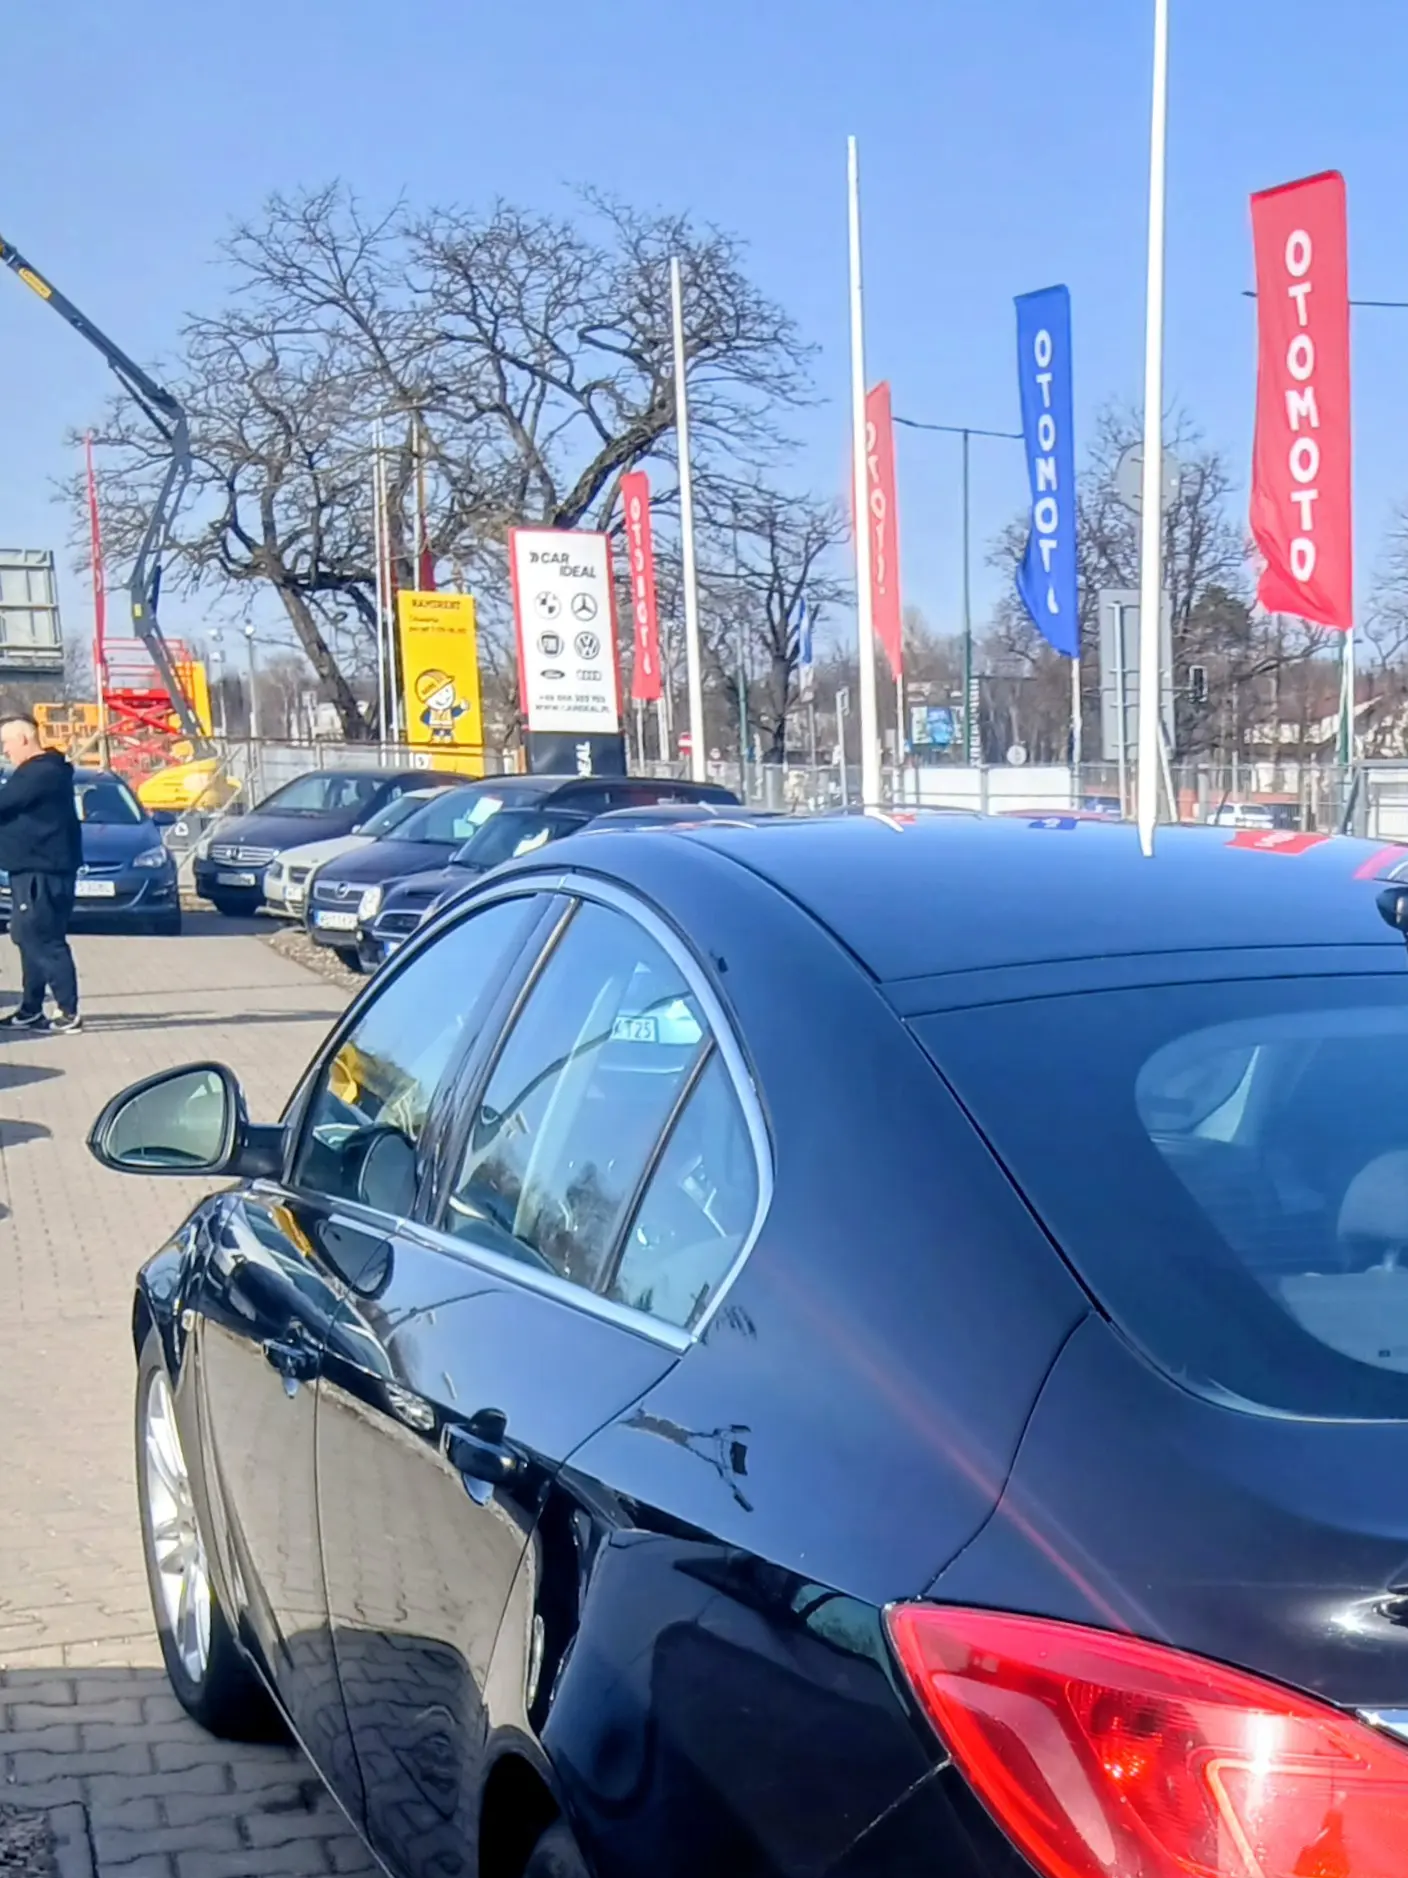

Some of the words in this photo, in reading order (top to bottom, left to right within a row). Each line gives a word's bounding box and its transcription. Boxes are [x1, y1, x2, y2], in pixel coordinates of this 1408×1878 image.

[1285, 229, 1320, 583] OTOMOTO
[541, 552, 570, 564] CAR
[560, 565, 597, 579] IDEAL
